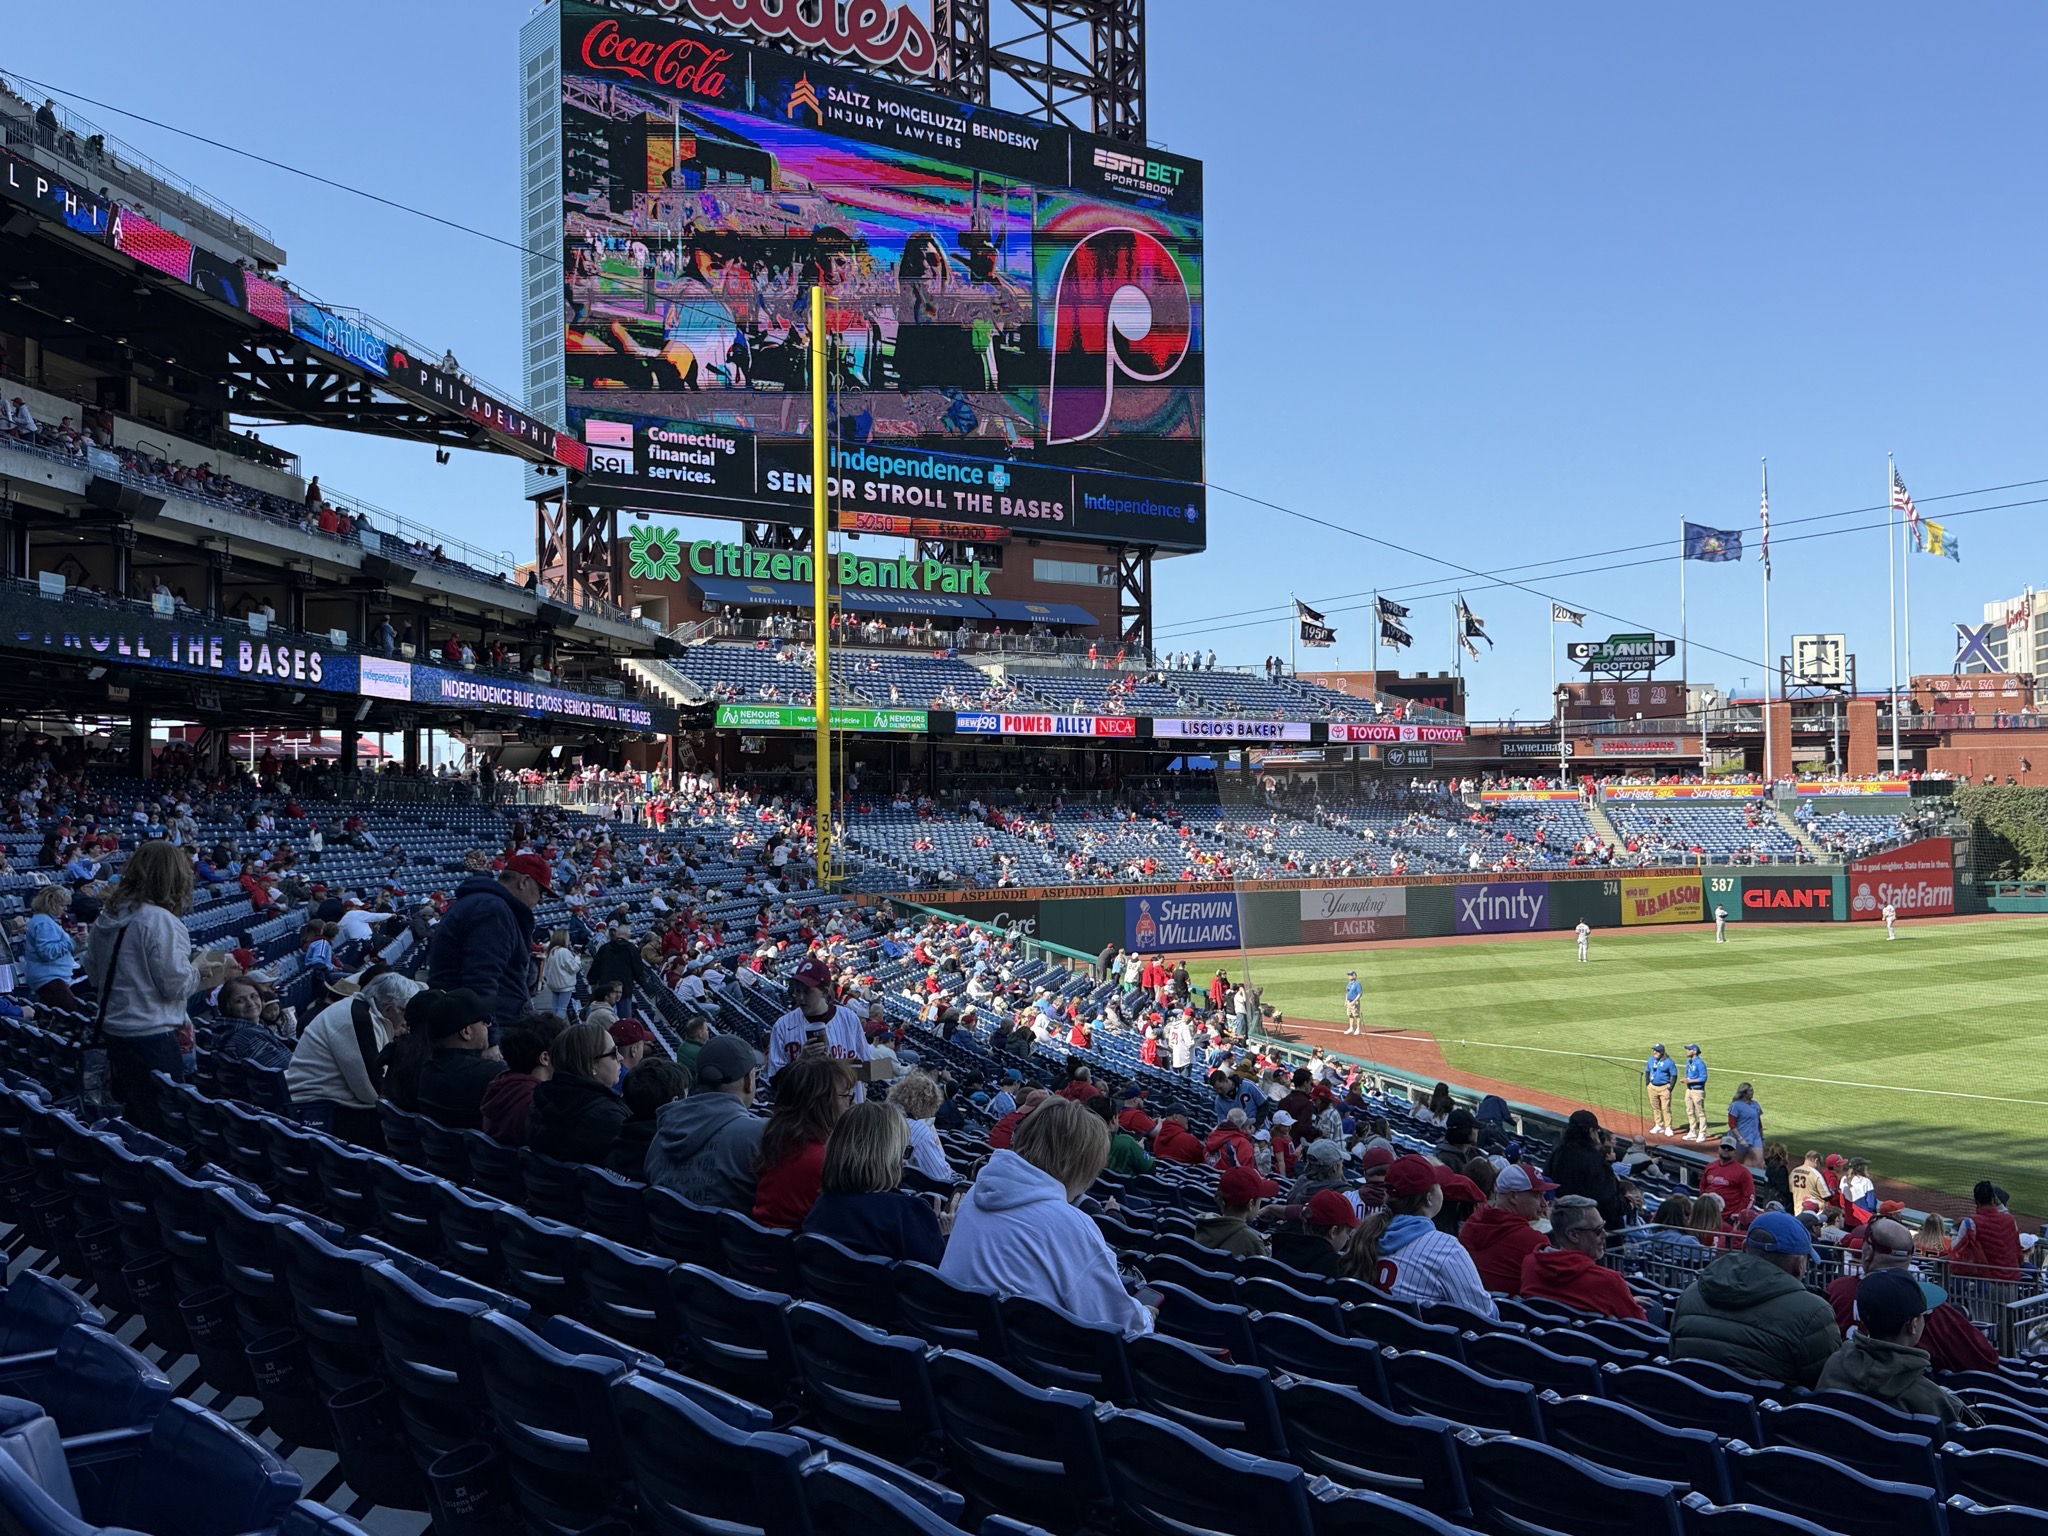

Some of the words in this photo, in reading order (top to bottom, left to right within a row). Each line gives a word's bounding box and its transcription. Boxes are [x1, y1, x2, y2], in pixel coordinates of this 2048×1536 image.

[581, 19, 734, 97] Coca-Cola
[828, 86, 871, 109] SALTZ
[877, 99, 967, 133] MONGELUZZI
[972, 123, 1040, 151] BENDESKY
[828, 106, 884, 130] INJURY
[896, 123, 962, 149] LAWYERS
[1104, 172, 1174, 196] SPORTSBOOK
[420, 370, 558, 452] PHILADELPHIA
[648, 426, 736, 455] Connecting
[648, 444, 716, 466] financial
[830, 445, 984, 485] Independence
[648, 466, 716, 484] services.
[766, 470, 856, 500] SENOR
[863, 481, 947, 510] STROLL
[954, 491, 993, 514] THE
[1000, 497, 1064, 521] BASES
[1083, 493, 1181, 518] Independence
[689, 538, 830, 582] Citizen
[838, 552, 919, 590] Bank
[923, 558, 992, 595] Park
[845, 591, 910, 605] HARRY
[1304, 624, 1328, 640] 1950
[1386, 623, 1407, 641] 1993
[1575, 644, 1600, 657] CP
[1602, 642, 1667, 656] RANKIN
[168, 632, 223, 668] THE
[239, 640, 323, 683] BASES
[1593, 662, 1650, 671] ROOFTOP
[362, 670, 403, 685] Independence
[1601, 688, 1614, 700] 14
[1627, 687, 1640, 700] 15
[1651, 687, 1666, 700] 20
[441, 679, 512, 706] INDEPENDENCE
[514, 690, 534, 709] BLUE
[535, 694, 563, 713] CROSS
[564, 699, 591, 717] SENIOR
[592, 703, 617, 721] STROLL
[618, 707, 632, 723] THE
[631, 709, 651, 726] BASES
[740, 710, 780, 719] NEMOURS
[798, 715, 811, 723] Well
[889, 715, 925, 723] NEMOURS
[1004, 716, 1052, 732] POWER
[1056, 717, 1092, 734] ALLEY
[1099, 719, 1135, 733] NECA
[1181, 721, 1234, 736] LISCIO'S
[1237, 722, 1285, 738] BAKERY
[1351, 726, 1396, 739] TOYOTA
[1421, 728, 1464, 741] TOYOTA
[1408, 749, 1427, 757] ALLEY
[1614, 787, 1655, 800] Surfside
[1691, 786, 1732, 799] Surfside
[1819, 782, 1860, 796] Surfside
[1851, 863, 1863, 871] Like
[1868, 862, 1881, 872] good
[1881, 862, 1904, 872] neighbor,
[1904, 861, 1917, 870] State
[1918, 861, 1931, 869] Farm
[1936, 860, 1950, 869] there.
[1382, 876, 1432, 886] ASPLUNDH
[1441, 874, 1489, 883] ASPLUNDH
[1498, 872, 1543, 882] ASPLUNDH
[1551, 870, 1595, 880] ASPLUNDH
[1603, 869, 1646, 879] ASPLUNDH
[1116, 884, 1177, 896] ASPLUNDH
[1188, 881, 1245, 893] ASPLUNDH
[1256, 879, 1311, 890] ASPLUNDH
[1321, 878, 1373, 888] ASPLUNDH
[1603, 881, 1619, 896] 374
[1711, 878, 1734, 892] 387
[961, 890, 1028, 901] ASPLUNDH
[1041, 887, 1105, 898] ASPLUNDH
[1160, 900, 1233, 922] SHERWIN
[1321, 892, 1387, 918] Yuengling
[1461, 887, 1544, 930] xfinity
[1159, 923, 1232, 945] WILLIAMS
[1333, 919, 1376, 936] LAGER
[697, 1158, 715, 1170] YOU
[677, 1176, 713, 1184] PLAYING
[1793, 1175, 1807, 1189] 23
[684, 1190, 713, 1201] AME
[277, 1364, 294, 1376] Bank
[265, 1376, 281, 1385] Park
[470, 1489, 490, 1504] Bank
[456, 1504, 475, 1515] Park
